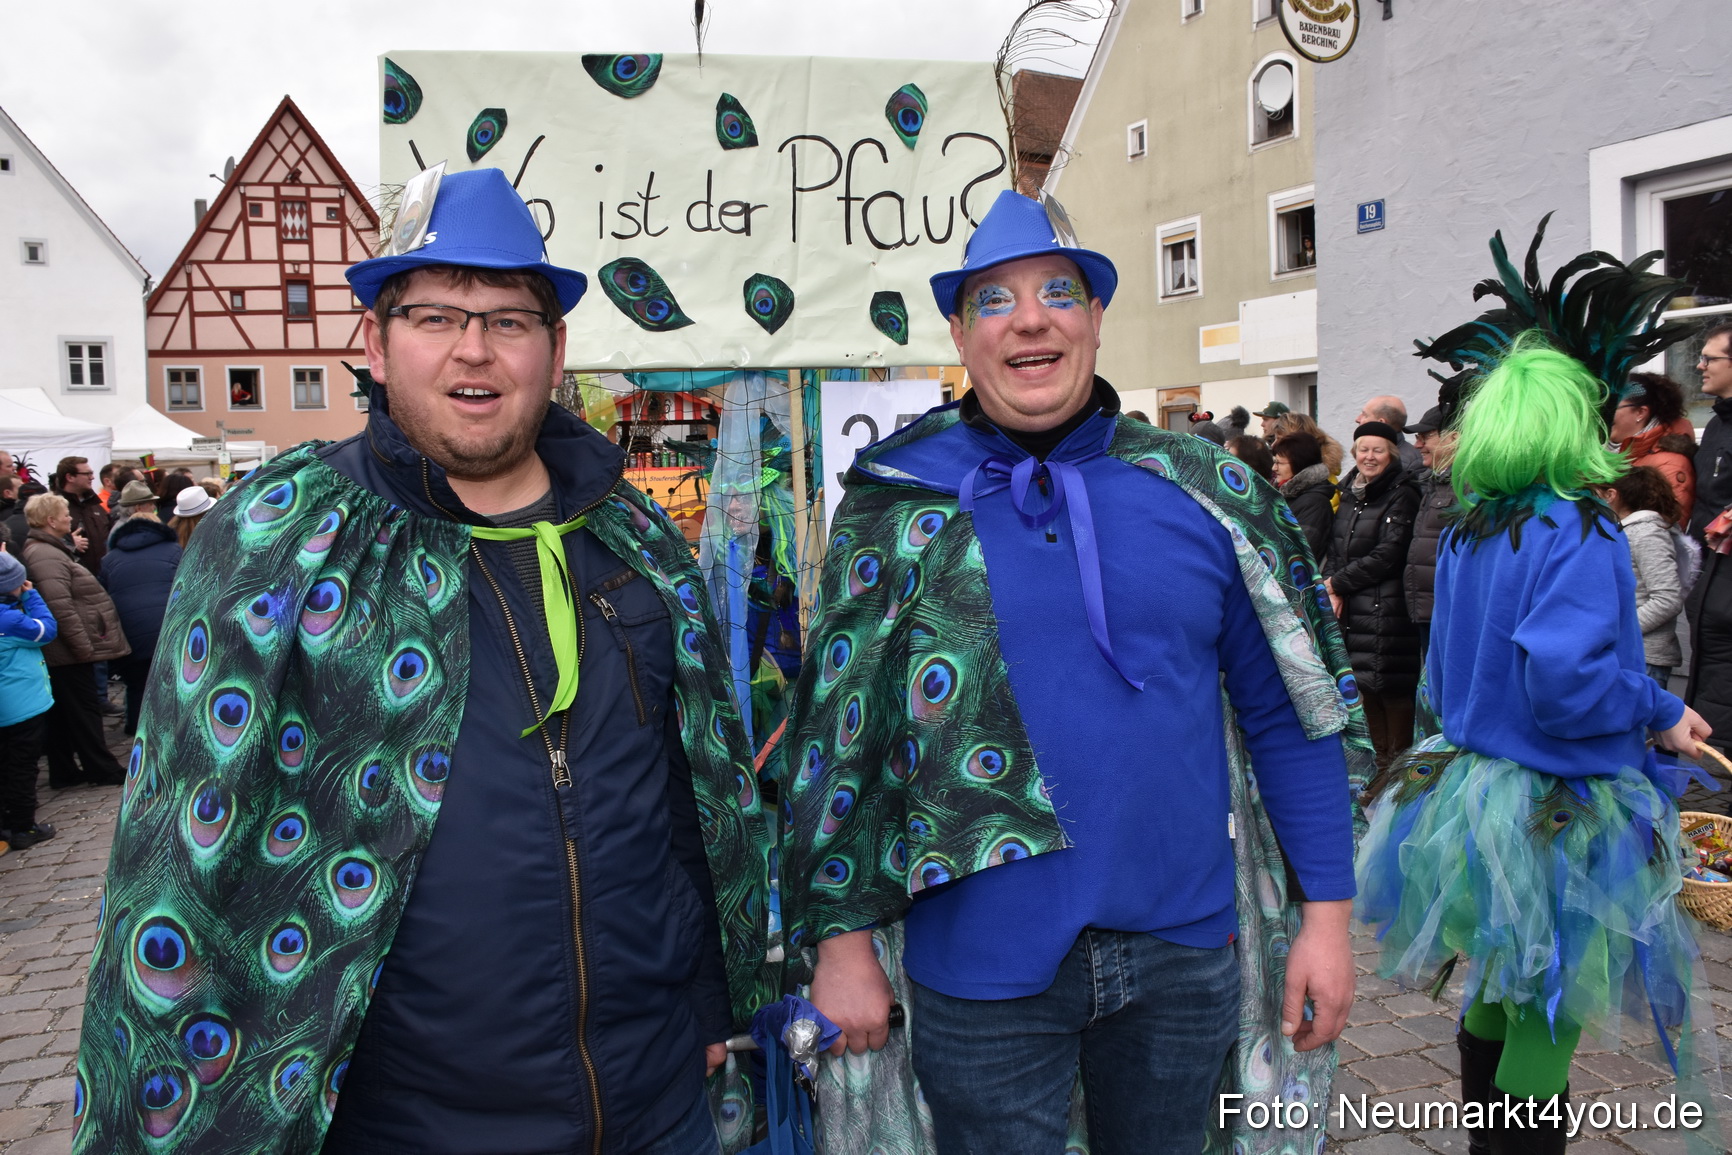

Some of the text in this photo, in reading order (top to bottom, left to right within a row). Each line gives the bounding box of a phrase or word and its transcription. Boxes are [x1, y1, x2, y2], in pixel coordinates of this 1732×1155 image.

[1302, 33, 1338, 50] BERCHING
[595, 164, 669, 239] ist
[686, 169, 769, 236] der
[1364, 204, 1376, 220] 19
